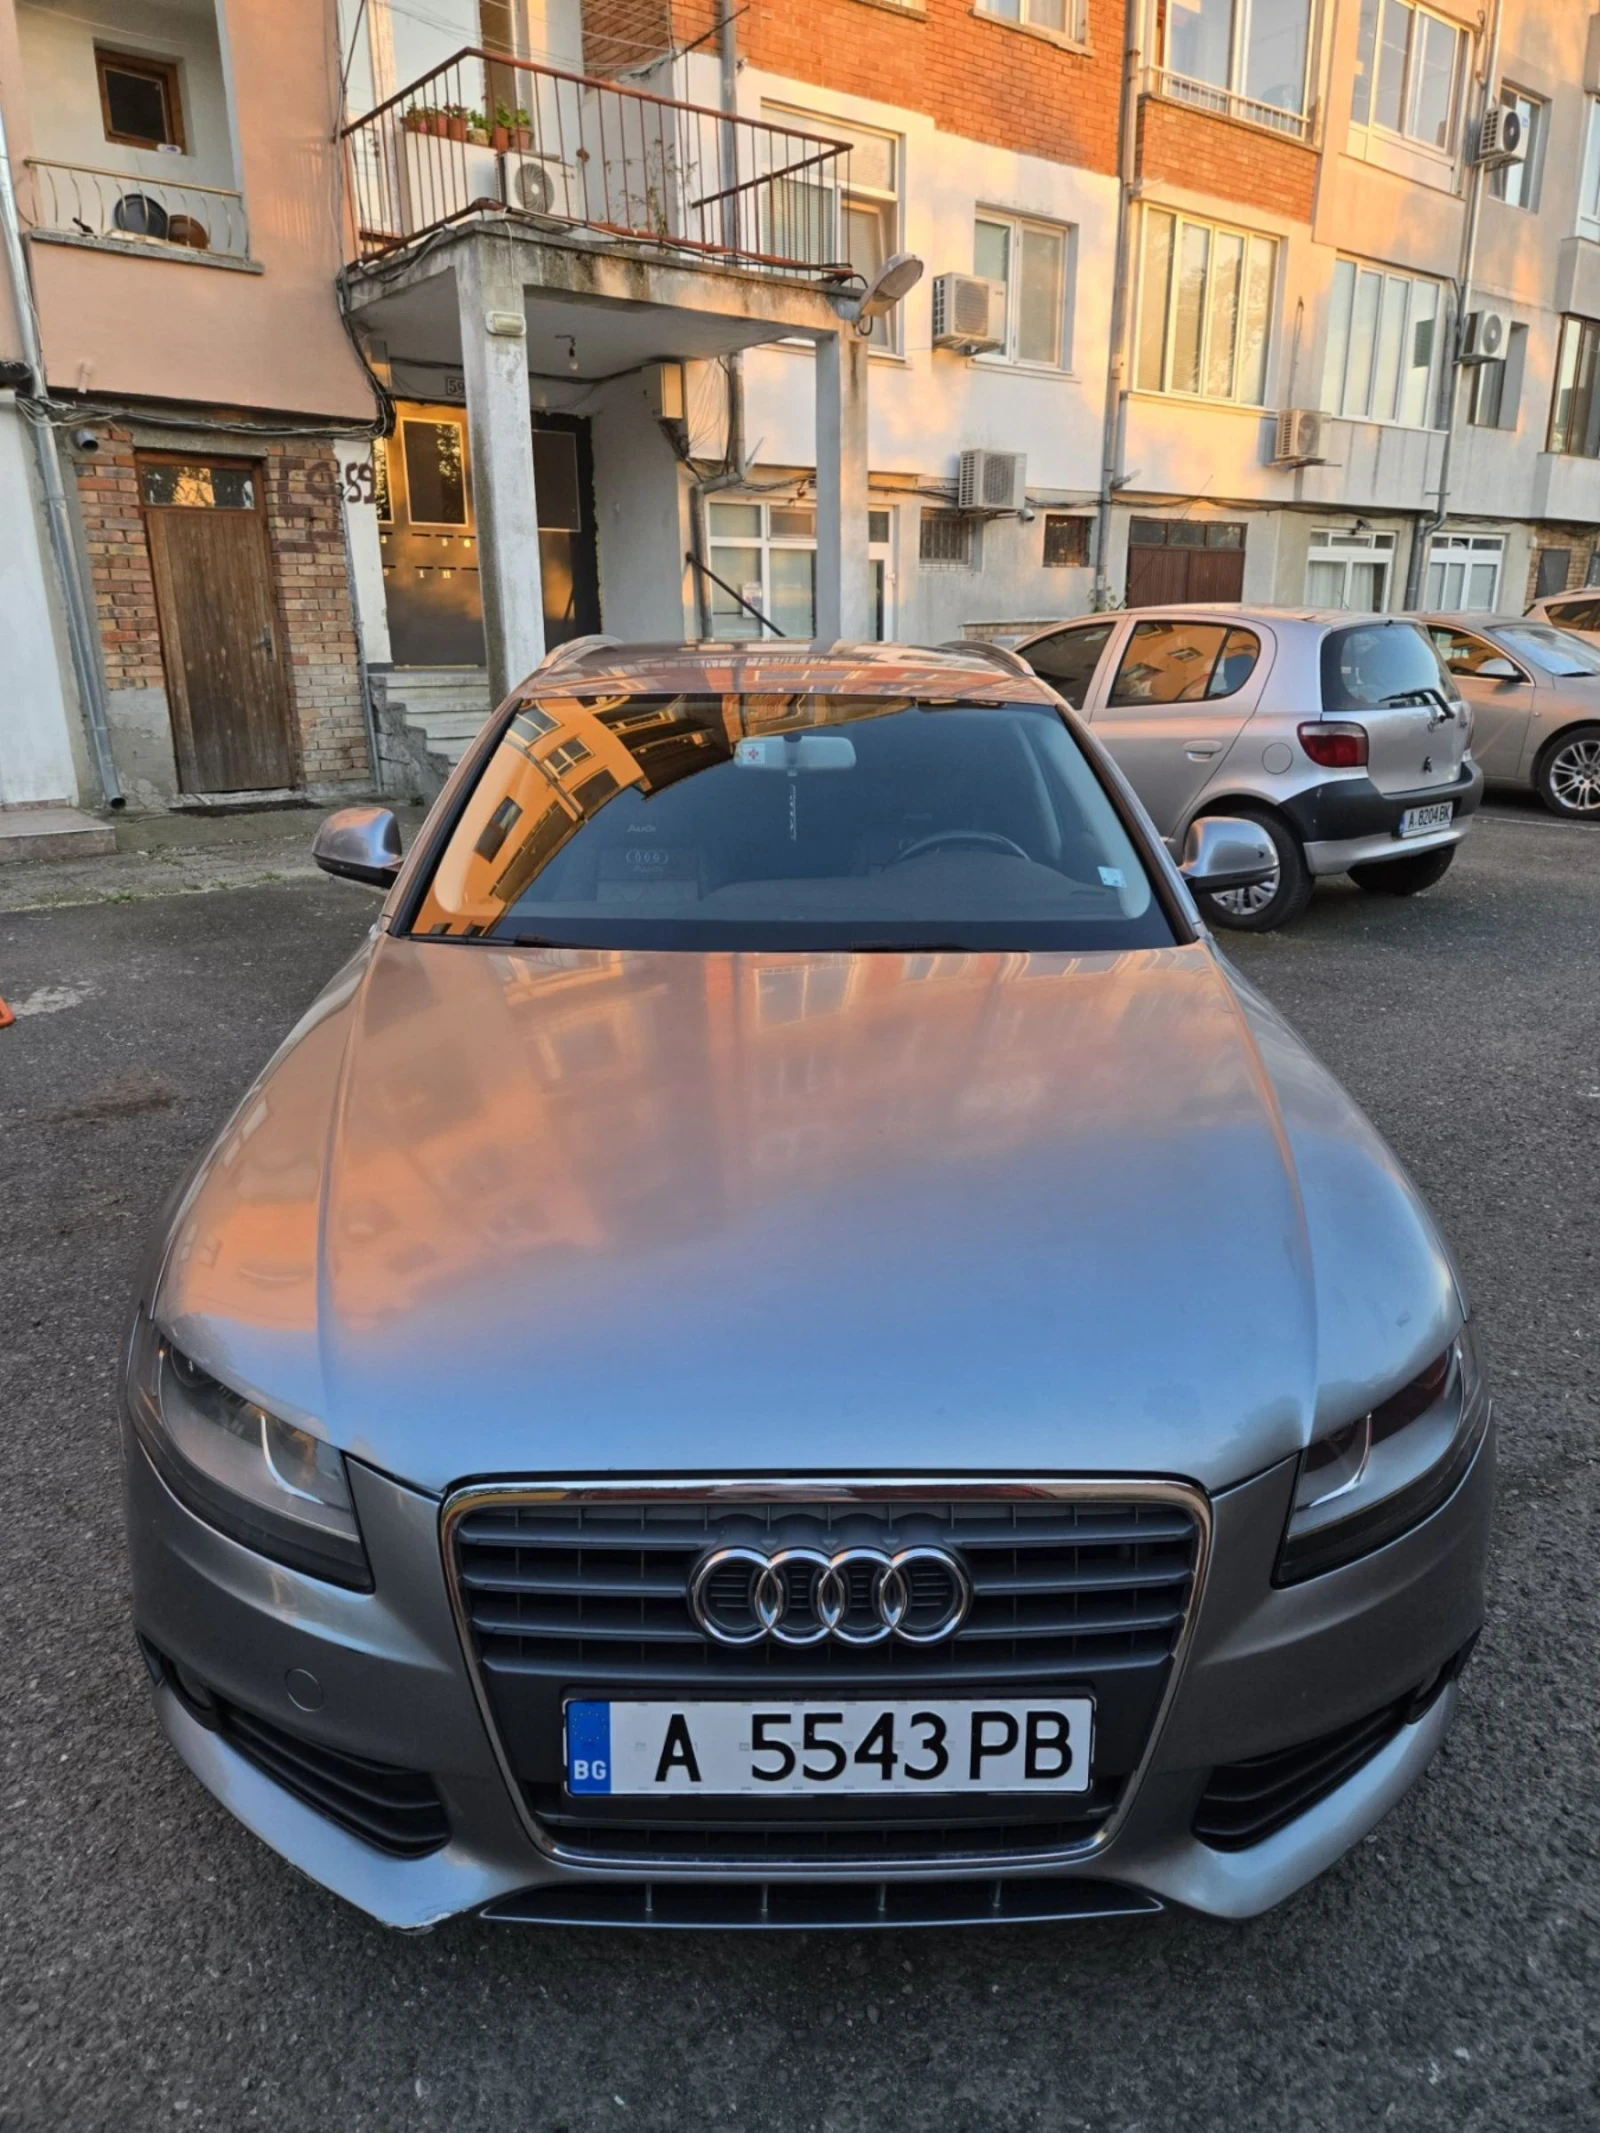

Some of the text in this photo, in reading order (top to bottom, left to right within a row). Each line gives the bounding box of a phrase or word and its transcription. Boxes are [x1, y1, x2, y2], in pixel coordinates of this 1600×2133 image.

[345, 462, 376, 504] 59
[1408, 812, 1415, 829] A
[1439, 804, 1452, 822] BK
[654, 1710, 1073, 1782] A 5543 PB
[574, 1759, 607, 1781] BG
